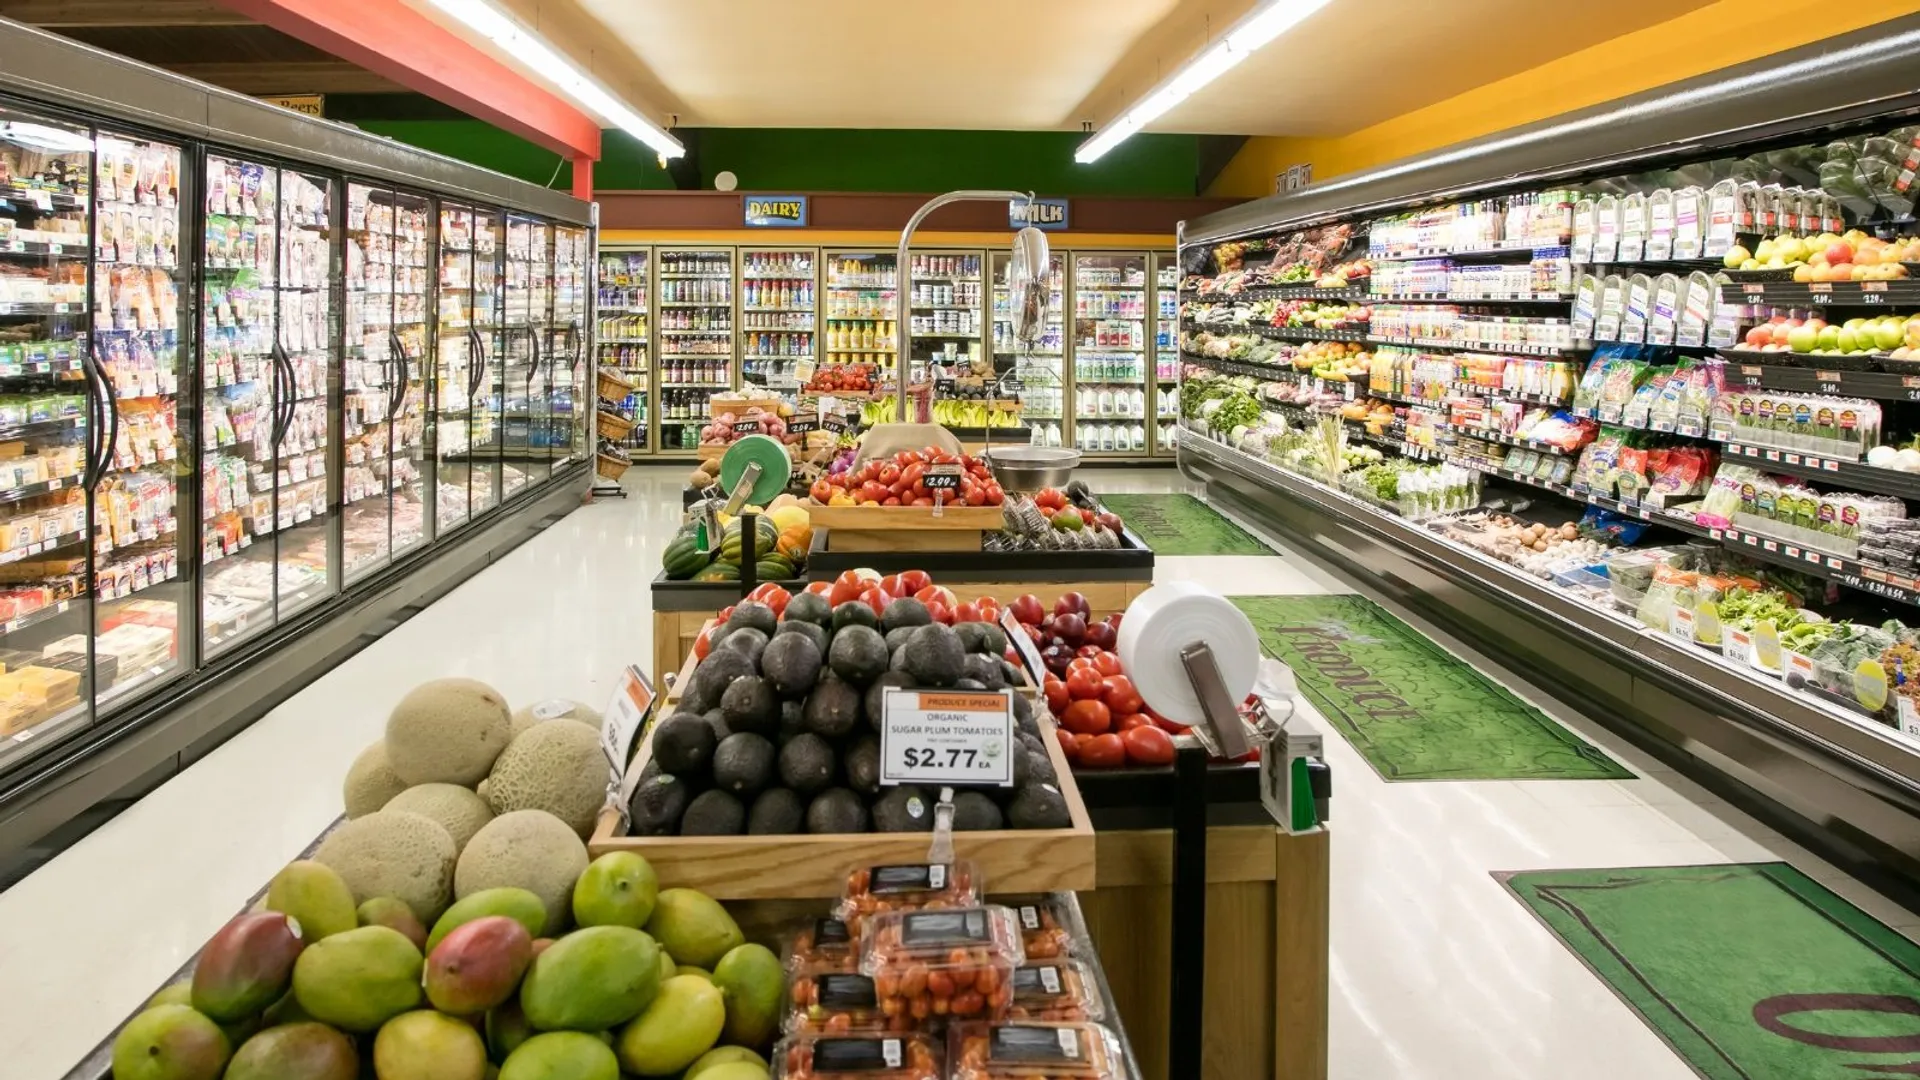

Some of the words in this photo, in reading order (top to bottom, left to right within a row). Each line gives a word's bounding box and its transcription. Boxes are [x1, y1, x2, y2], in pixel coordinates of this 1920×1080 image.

[749, 201, 801, 218] DAIRY
[1013, 203, 1063, 222] MILK
[1275, 626, 1428, 720] PRODUCE
[970, 699, 1000, 707] SPECIAL
[927, 713, 968, 722] ORGANIC
[891, 725, 922, 734] SUGAR
[925, 726, 951, 735] PLUM
[954, 727, 1003, 736] TOMATOES
[903, 747, 978, 769] $2.77
